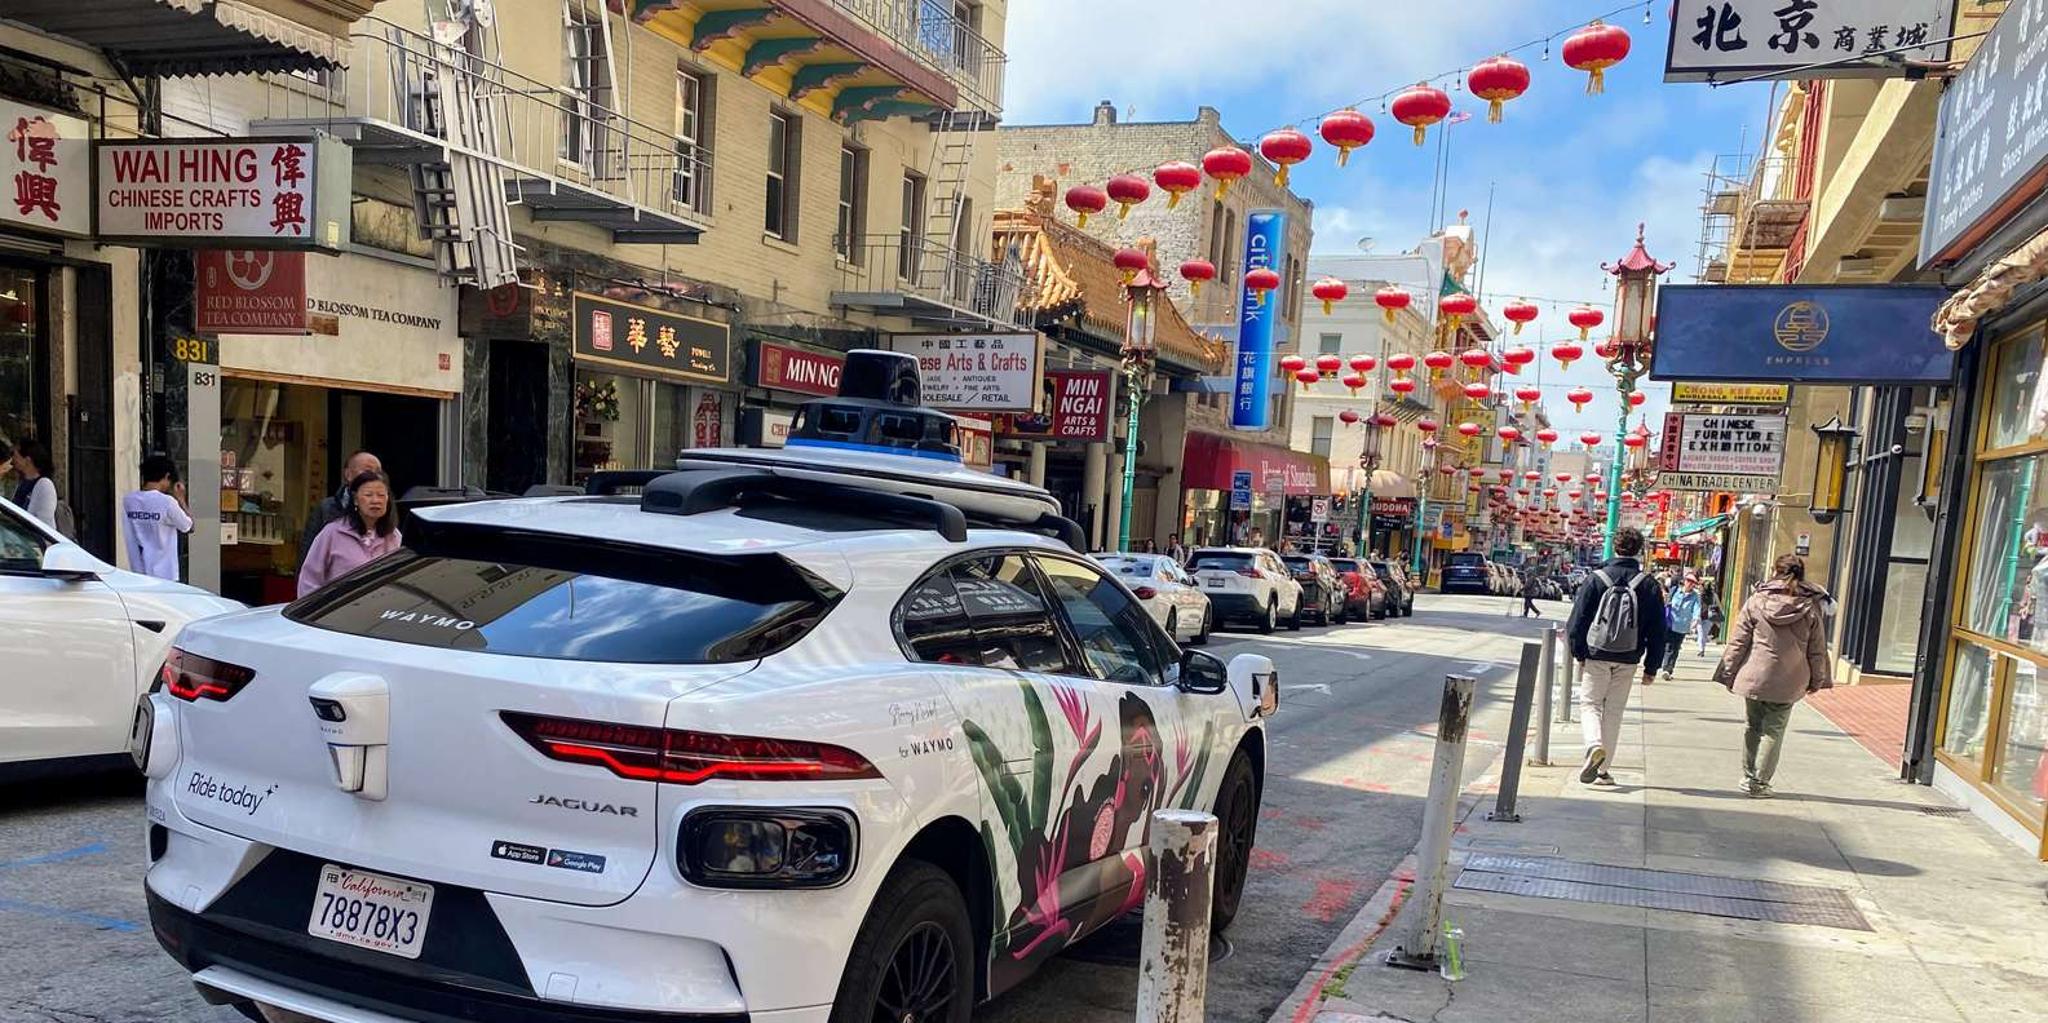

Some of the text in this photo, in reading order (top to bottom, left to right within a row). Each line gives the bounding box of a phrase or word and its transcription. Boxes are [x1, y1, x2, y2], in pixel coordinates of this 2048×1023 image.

[1693, 0, 1820, 53] 北京
[113, 149, 258, 183] WAI HING
[109, 189, 261, 208] CHINESE CRAFTS
[269, 143, 306, 236] 偉興
[144, 212, 223, 231] IMPORTS
[206, 295, 296, 309] RED BLOSSOM
[205, 310, 297, 326] TEA COMPANY
[318, 300, 369, 318] BLOSSOM
[370, 308, 390, 321] TEA
[391, 312, 441, 330] COMPANY
[176, 338, 208, 362] 831
[946, 352, 973, 371] Arts
[977, 352, 986, 371] &
[991, 351, 1027, 371] Crafts
[195, 371, 215, 386] 831
[786, 356, 817, 383] MIN
[818, 363, 840, 388] NG
[963, 384, 979, 392] FINE
[982, 384, 1001, 392] ARTS
[1065, 378, 1099, 396] MIN
[981, 393, 1011, 403] RETAIL
[1060, 396, 1102, 414] NGAI
[1064, 415, 1096, 426] ARTS &
[1703, 418, 1755, 429] CHINESE
[1061, 425, 1097, 436] CRAFTS
[1694, 430, 1774, 442] FURNITURE
[1689, 440, 1772, 452] EXHIBITION
[1662, 474, 1774, 491] CHINA TRADE CENTER
[381, 609, 475, 630] WAYMO
[910, 737, 954, 756] WAYMO
[187, 771, 264, 816] Ride today
[529, 794, 639, 817] JAGUAR
[507, 850, 540, 861] App Store
[564, 858, 602, 872] Google Play
[326, 872, 340, 883] FEB
[341, 874, 404, 899] California
[320, 892, 418, 945] 78878X3
